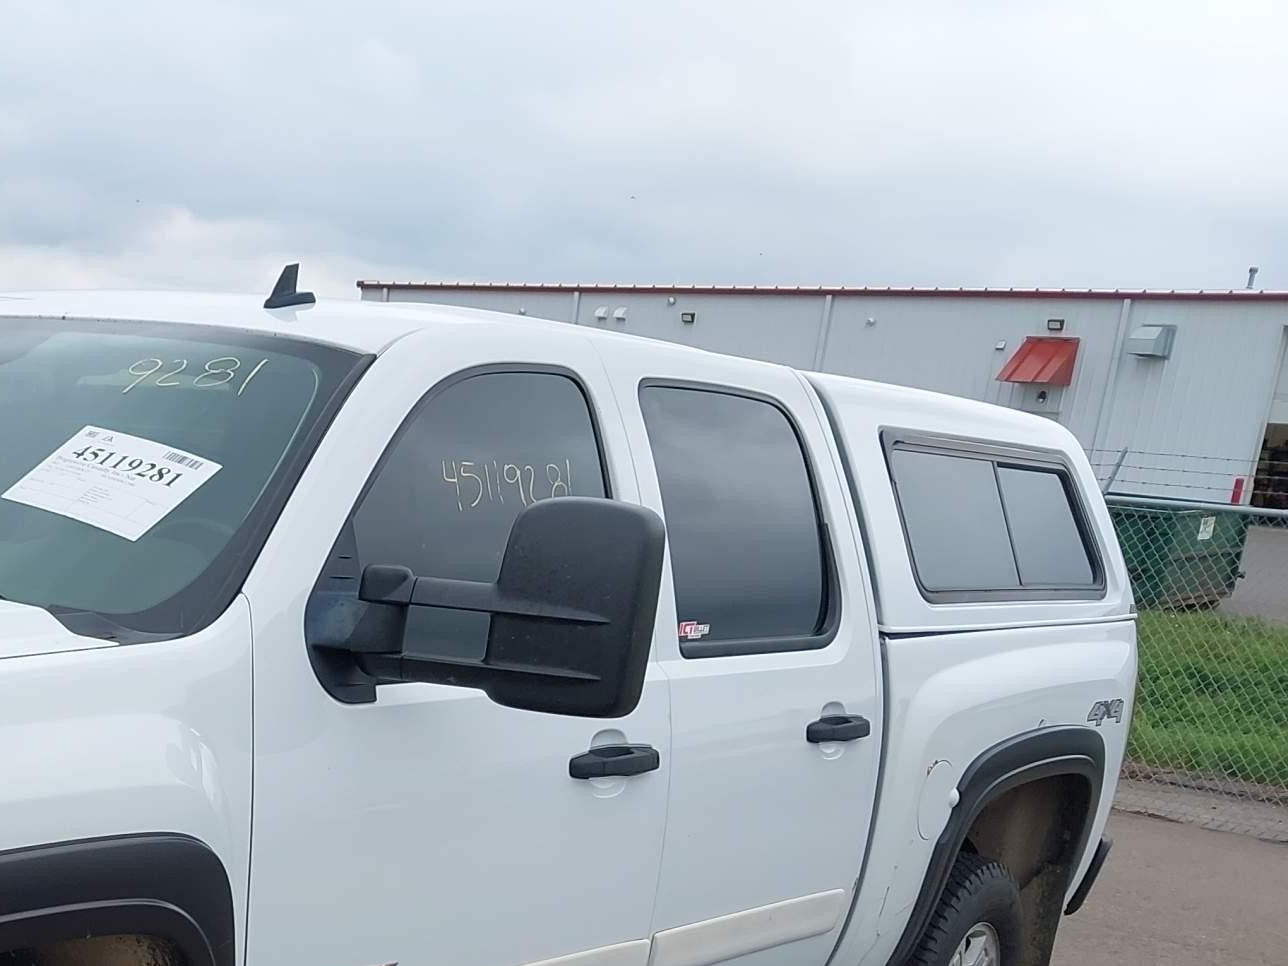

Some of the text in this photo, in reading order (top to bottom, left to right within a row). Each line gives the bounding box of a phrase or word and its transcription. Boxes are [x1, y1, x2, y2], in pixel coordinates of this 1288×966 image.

[121, 356, 268, 396] 9281
[72, 445, 183, 487] 45119281
[441, 458, 573, 512] 45119281
